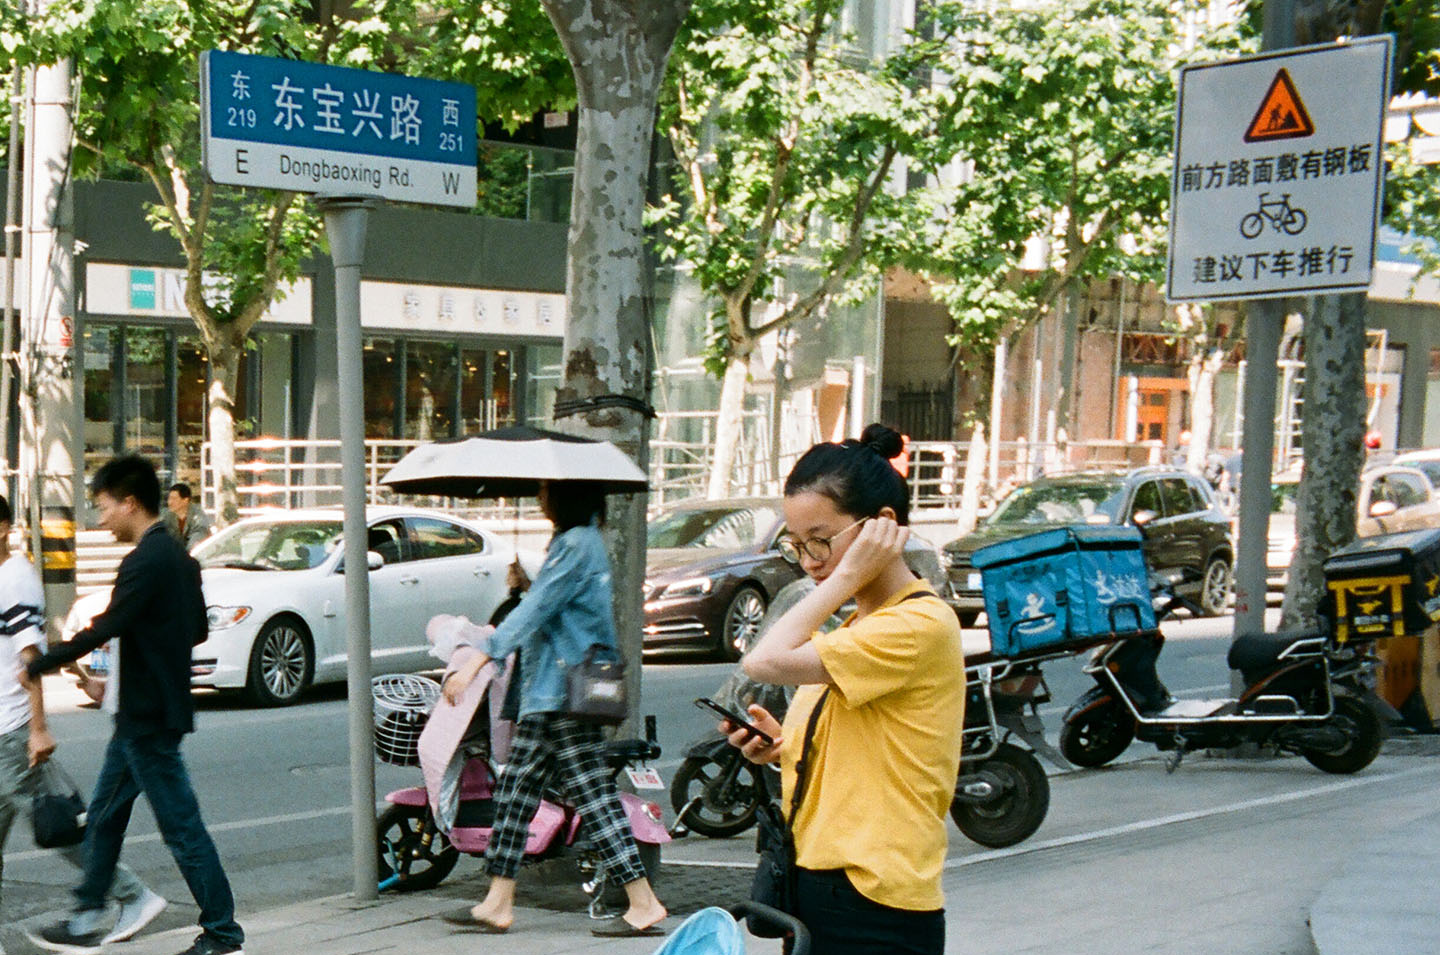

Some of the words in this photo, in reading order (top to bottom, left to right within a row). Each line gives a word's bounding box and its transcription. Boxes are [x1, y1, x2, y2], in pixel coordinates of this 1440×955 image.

[231, 70, 251, 101] 东
[227, 106, 257, 129] 219
[272, 76, 423, 146] 东宝兴路
[441, 98, 460, 127] 西
[439, 132, 464, 153] 251
[235, 149, 249, 175] E
[280, 154, 382, 189] Dongbaoxing
[389, 166, 414, 188] Rd.
[1181, 143, 1373, 192] 前方路面敷有钢板
[442, 171, 460, 196] W
[1192, 245, 1354, 285] 建议下车推行
